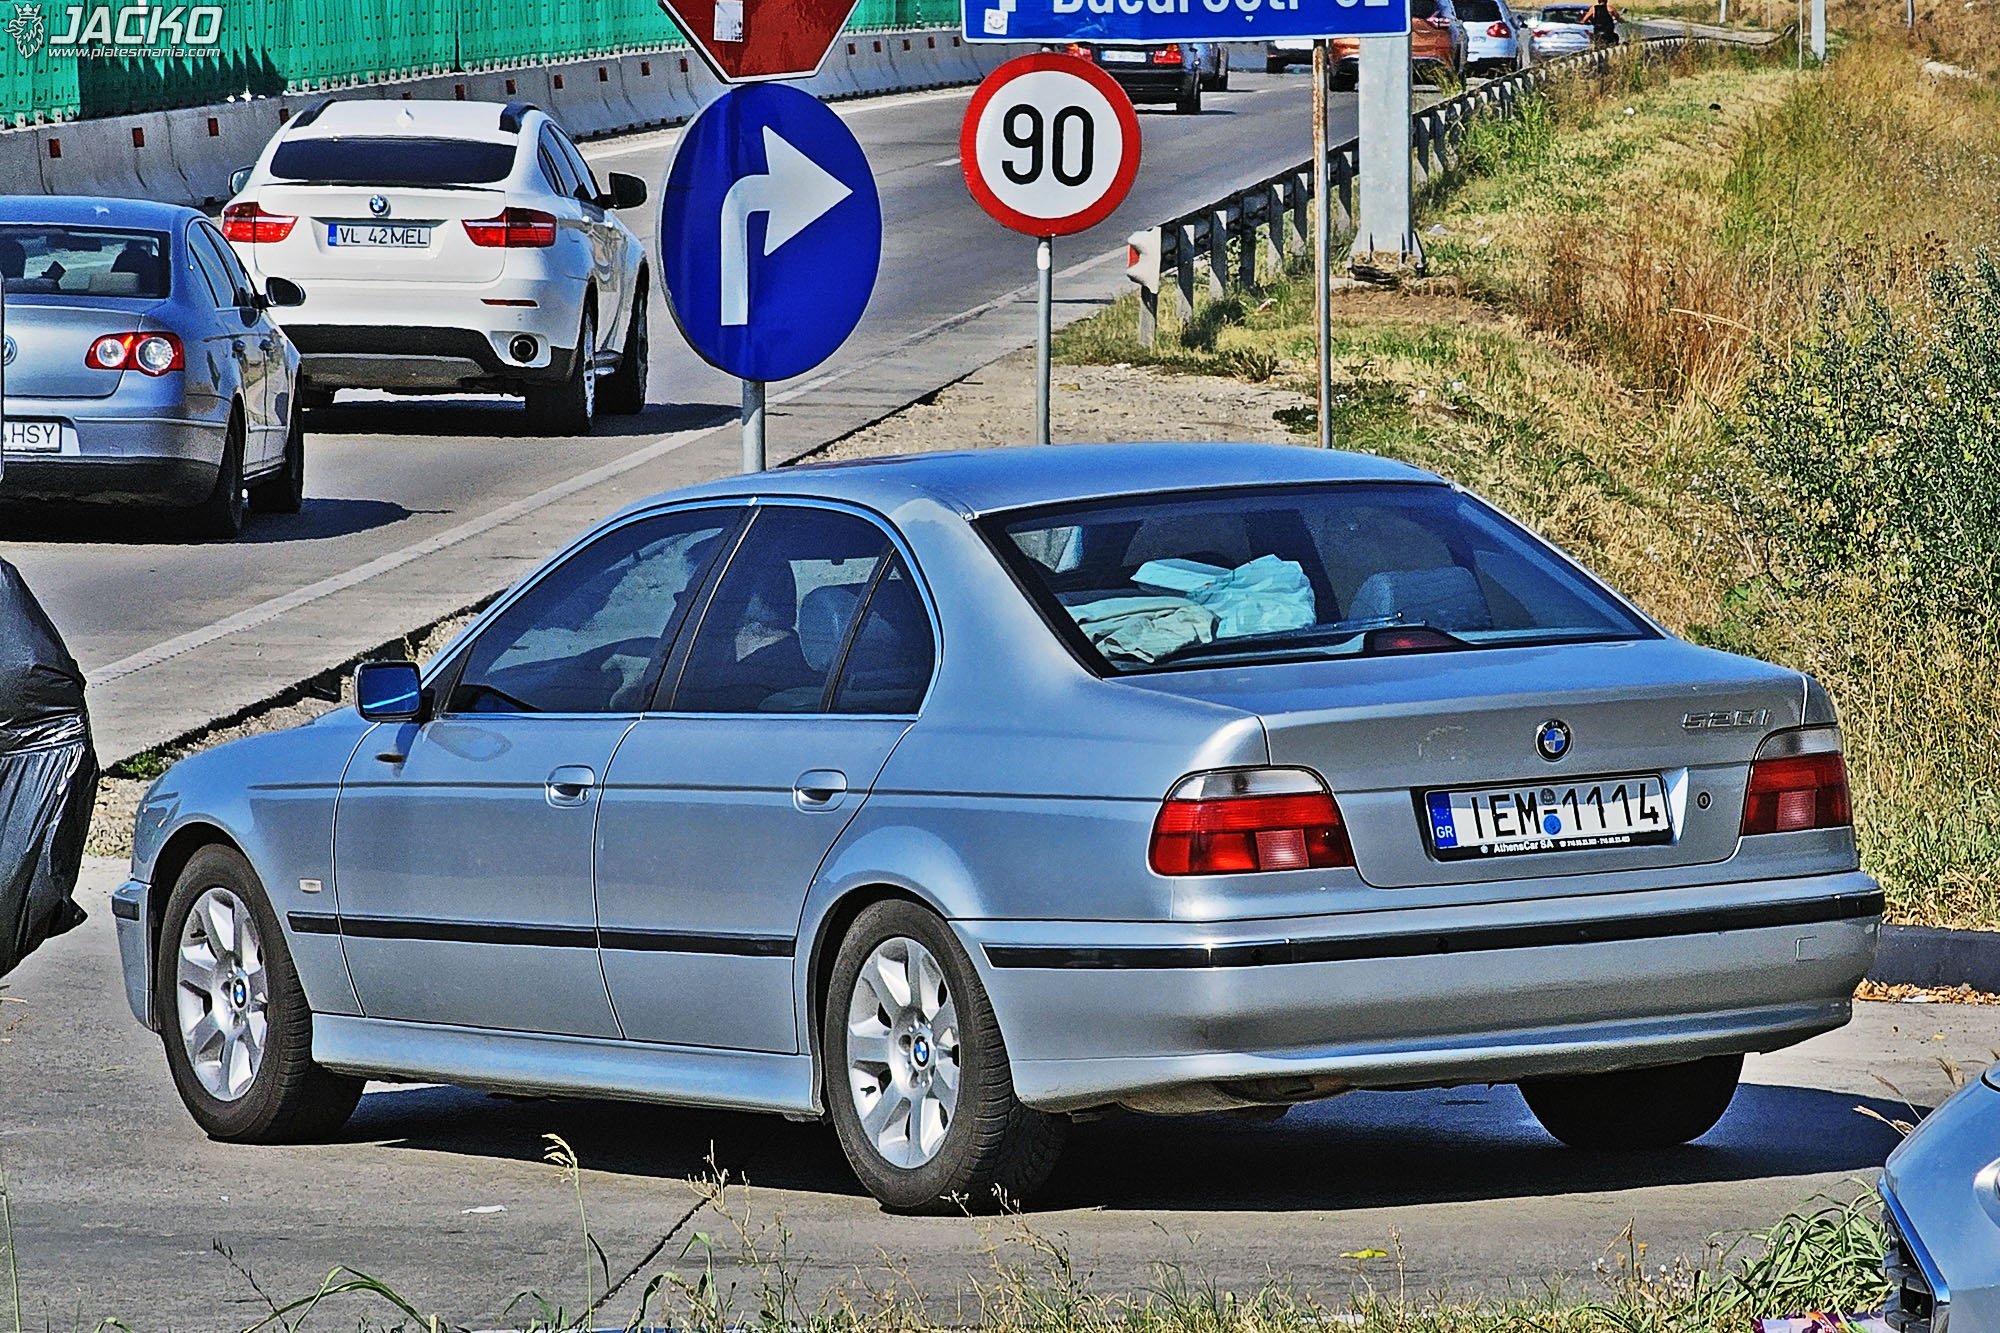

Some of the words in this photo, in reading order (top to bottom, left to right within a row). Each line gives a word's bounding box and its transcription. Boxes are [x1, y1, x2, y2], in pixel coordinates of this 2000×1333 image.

[1002, 103, 1095, 187] 90
[339, 227, 361, 244] VL
[1436, 825, 1454, 840] GR
